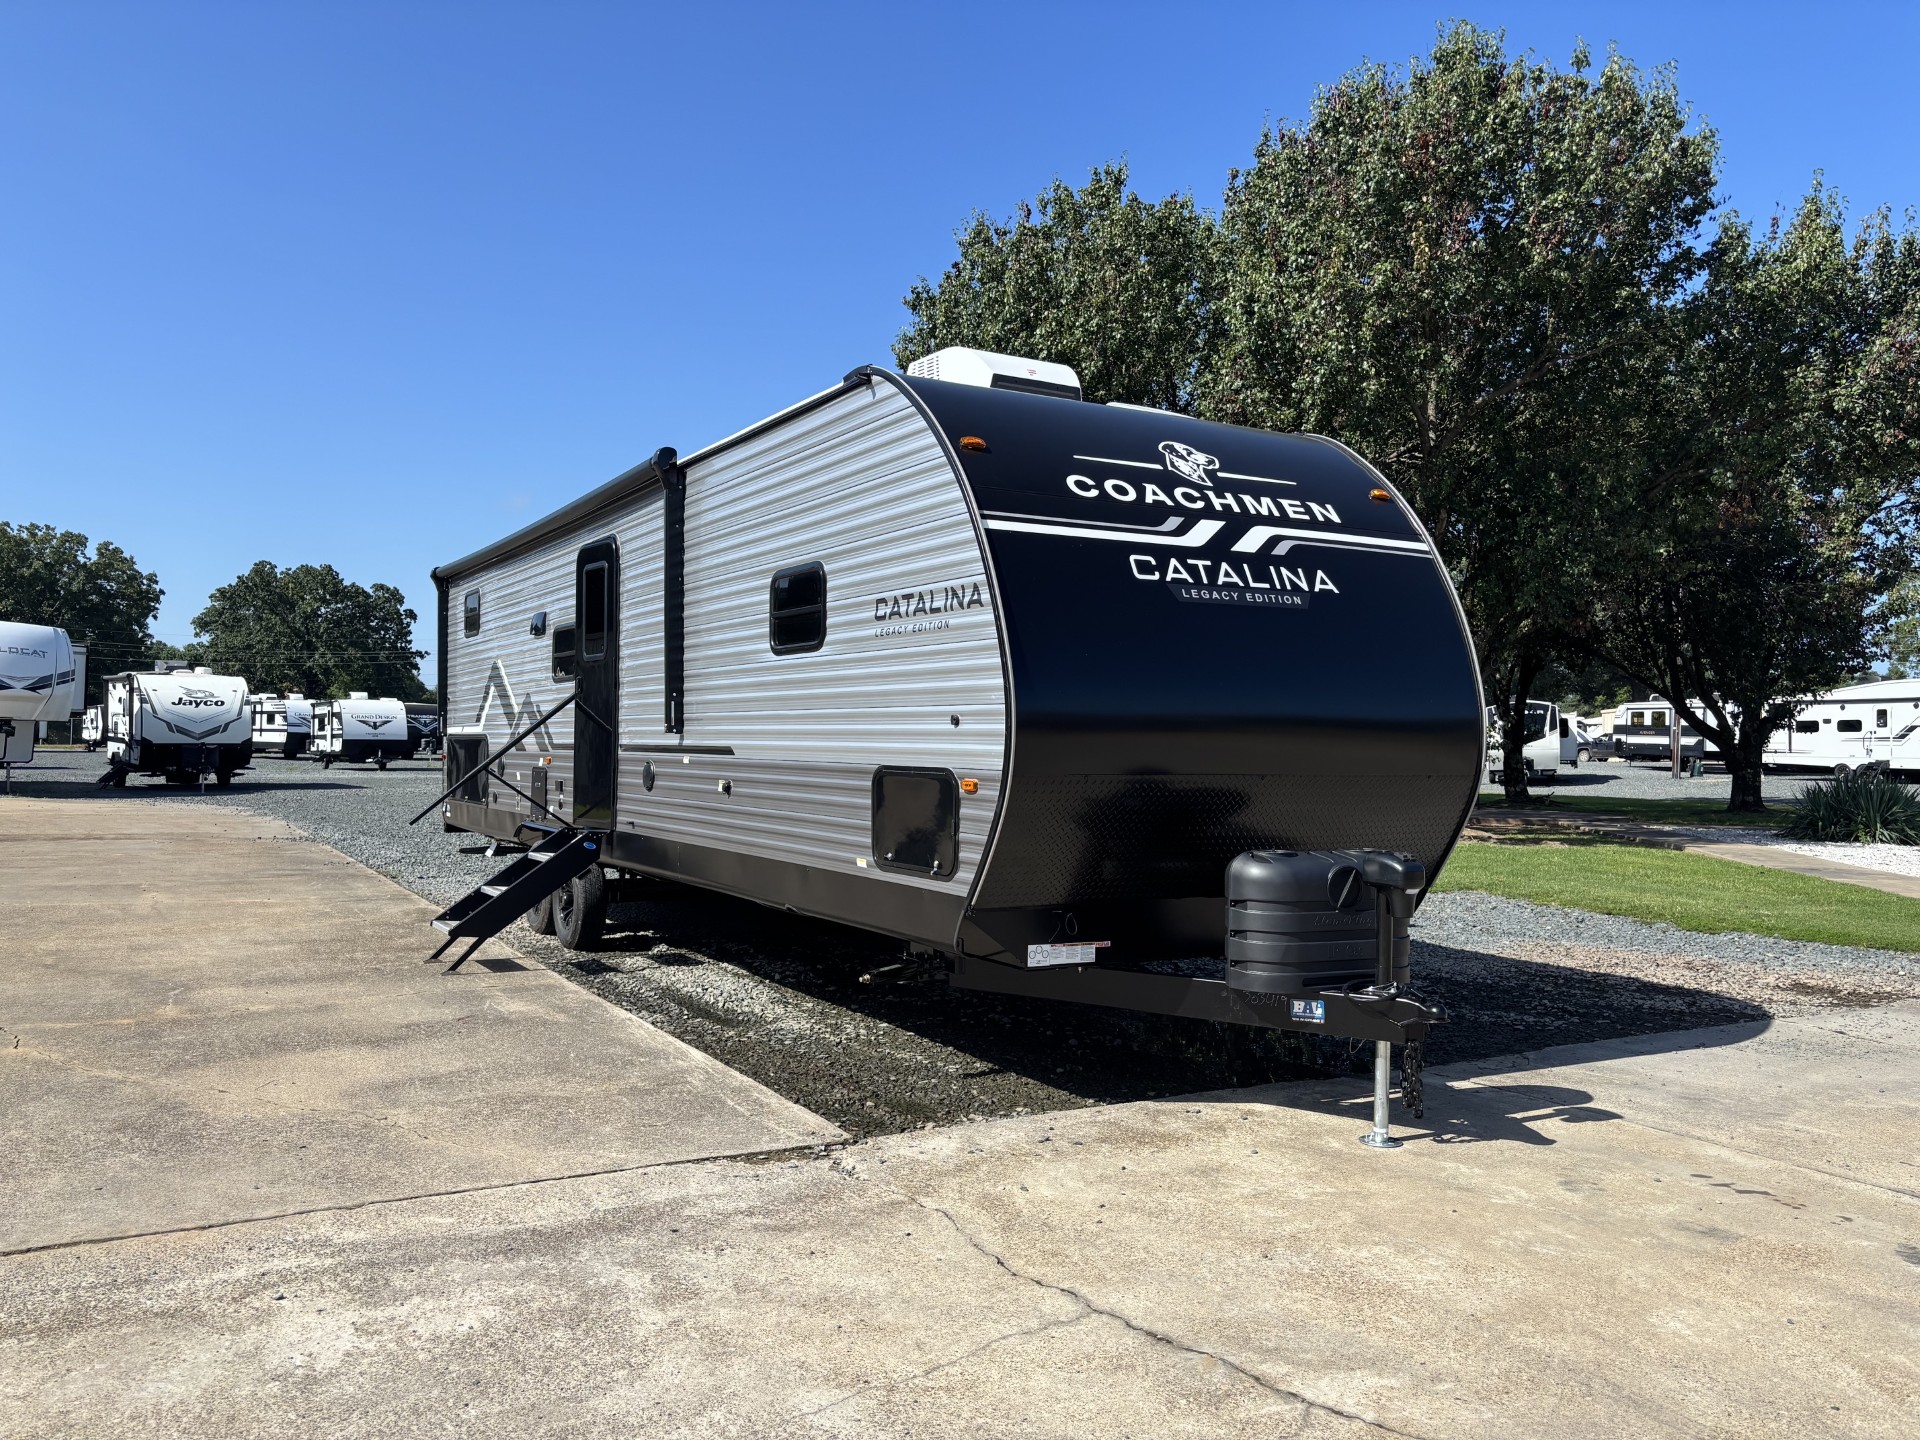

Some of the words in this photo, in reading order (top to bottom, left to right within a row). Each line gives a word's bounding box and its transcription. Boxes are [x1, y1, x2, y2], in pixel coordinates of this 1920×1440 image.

[1066, 474, 1342, 524] COACHMEN
[1129, 554, 1340, 594] CATALINA
[874, 582, 985, 622] CATALINA
[1181, 588, 1240, 602] LEGACY
[1245, 592, 1303, 606] EDITION
[874, 626, 909, 638] LEGACY
[912, 620, 951, 633] EDITION
[171, 696, 226, 709] Jayco
